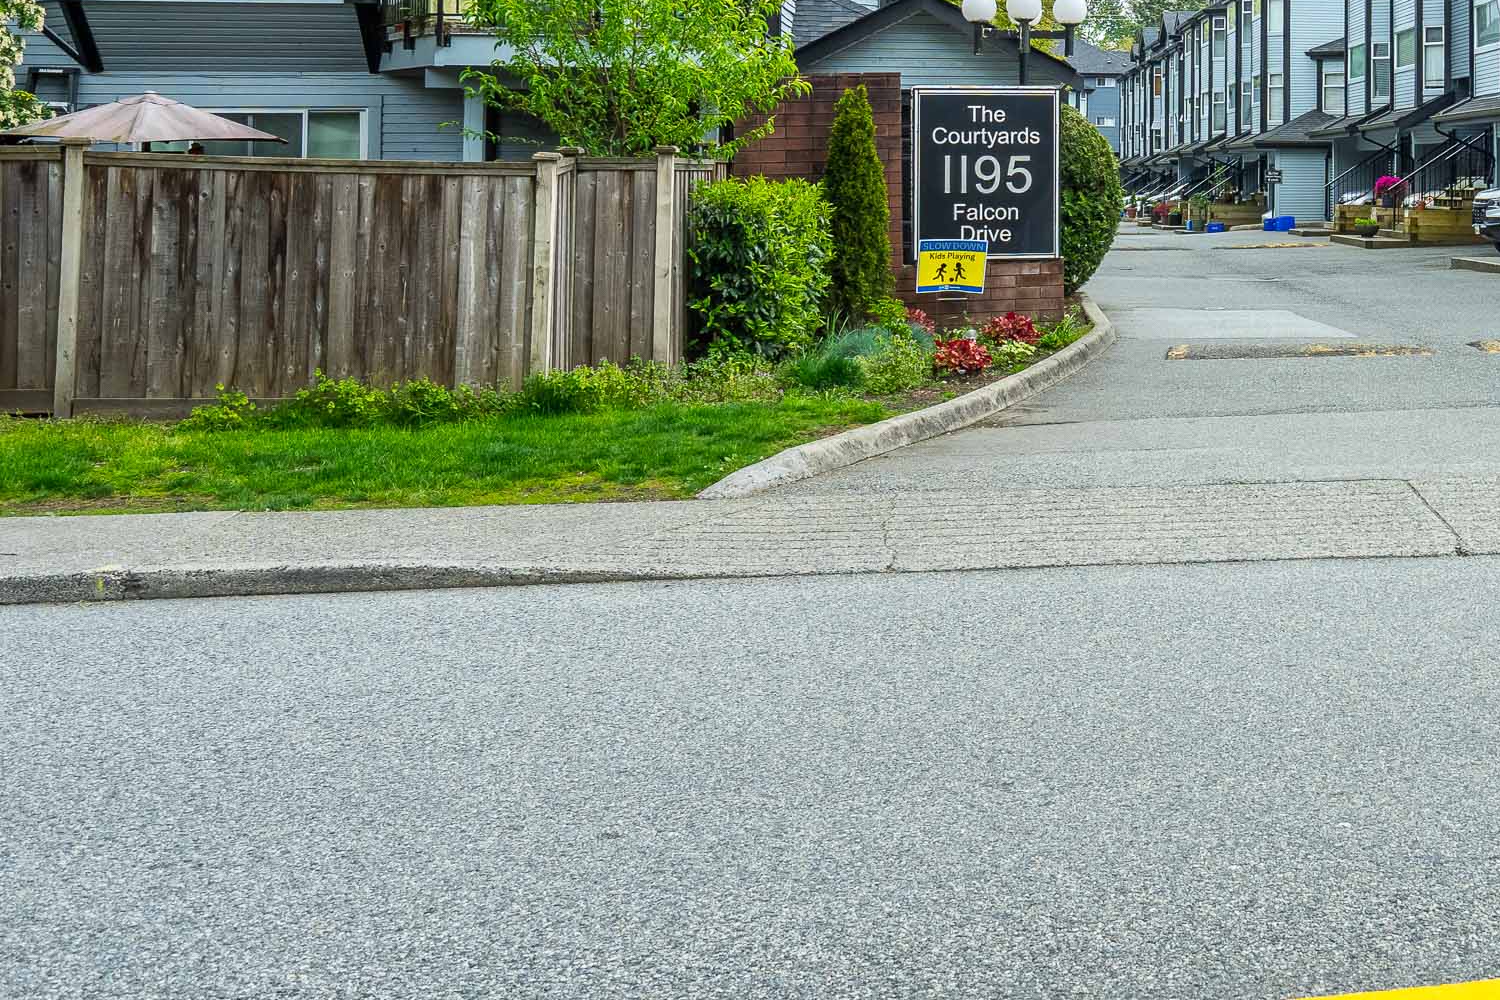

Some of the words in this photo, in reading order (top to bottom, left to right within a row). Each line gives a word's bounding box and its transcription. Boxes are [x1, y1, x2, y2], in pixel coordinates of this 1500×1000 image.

[967, 105, 1006, 123] The
[932, 127, 1041, 149] Courtyards
[944, 155, 1033, 194] 1195
[953, 203, 1019, 221] Falcon
[960, 225, 1012, 242] Drive
[922, 242, 952, 250] SLOW
[952, 242, 984, 251] DOWN
[947, 253, 976, 261] Playing
